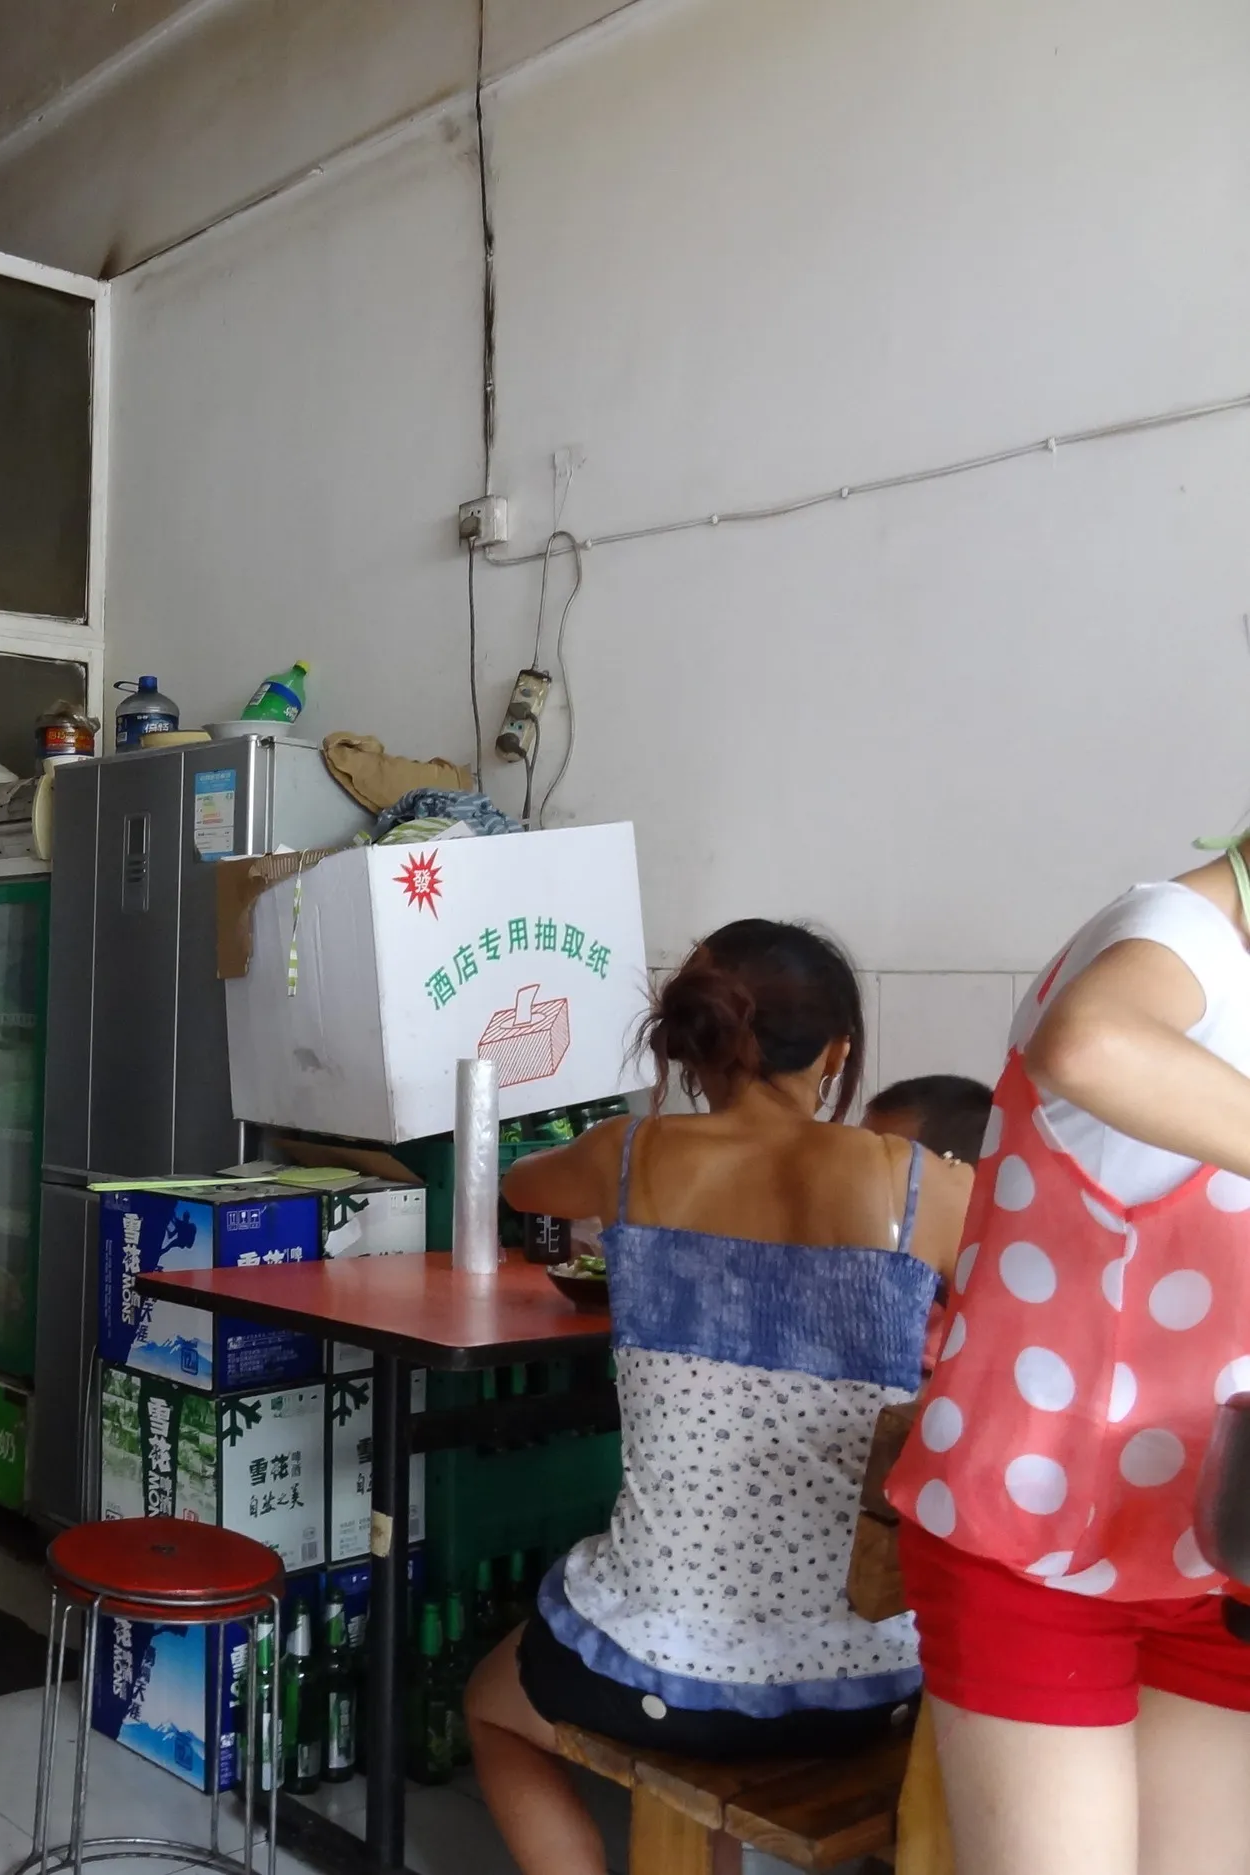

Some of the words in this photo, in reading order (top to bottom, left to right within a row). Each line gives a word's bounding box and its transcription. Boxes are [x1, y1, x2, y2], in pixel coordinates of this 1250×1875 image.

[414, 871, 431, 894] 發
[425, 916, 611, 1010] 酒店专用抽取纸
[122, 1213, 143, 1274] 雪花
[147, 1397, 175, 1474] 雪花
[249, 1453, 290, 1487] 雪花
[249, 1483, 305, 1519] 自然之美
